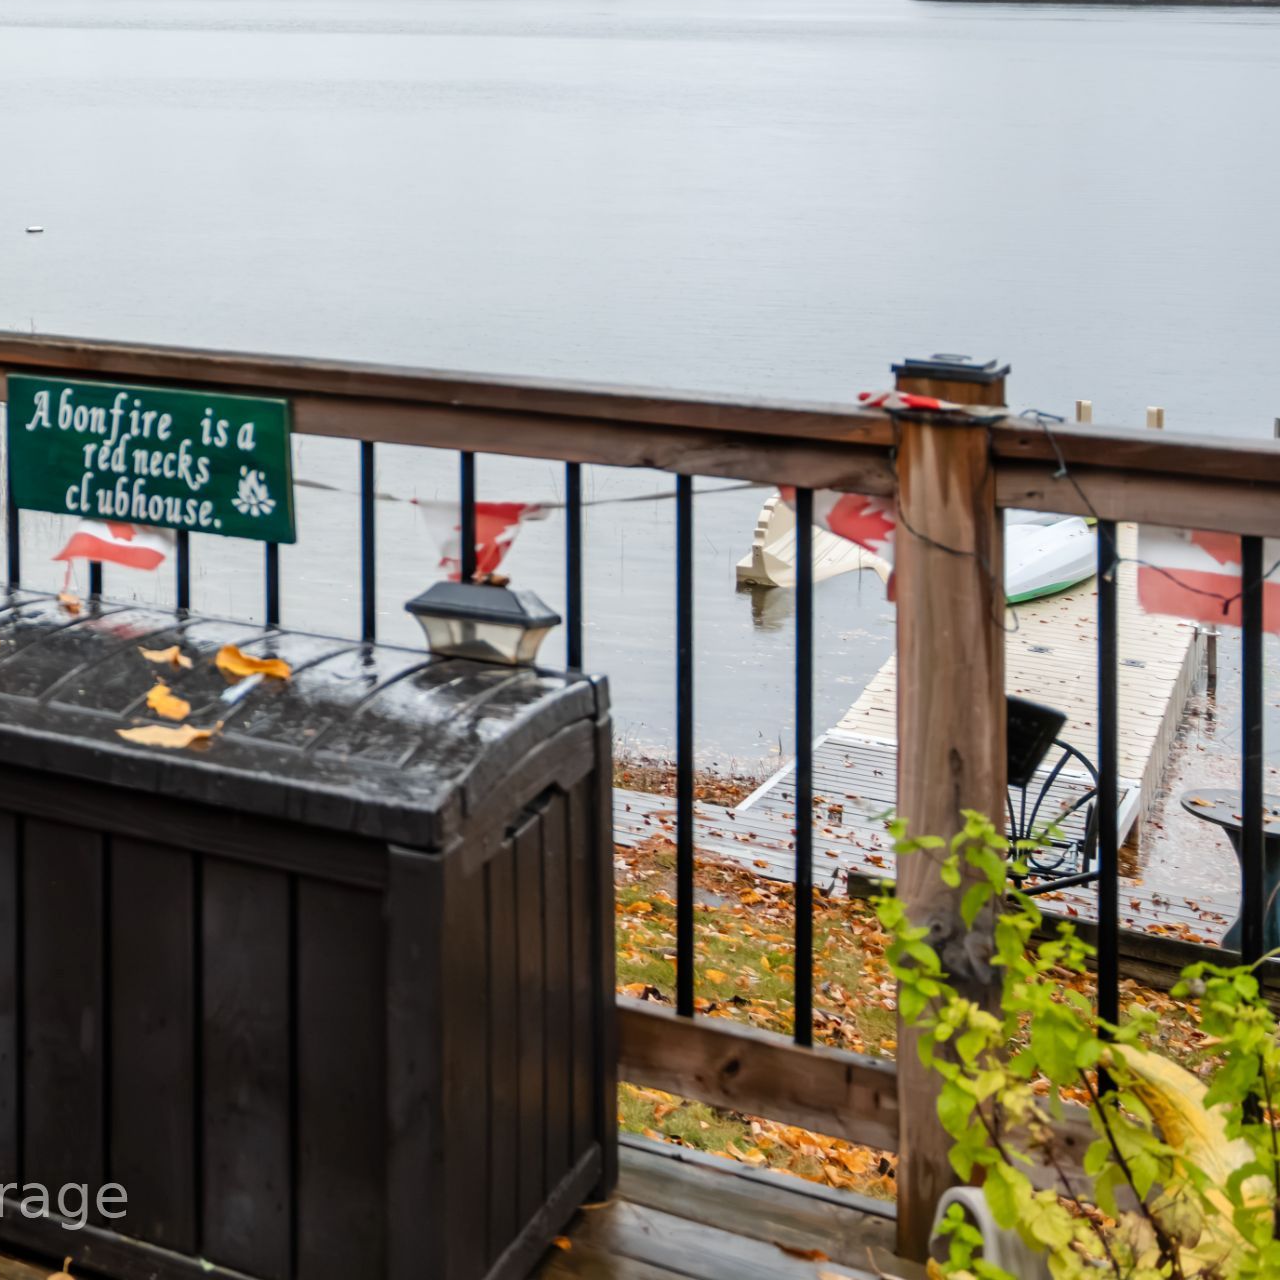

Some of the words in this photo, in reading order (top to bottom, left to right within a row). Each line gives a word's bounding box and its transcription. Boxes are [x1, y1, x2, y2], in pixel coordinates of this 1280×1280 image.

[25, 390, 52, 432] A
[58, 387, 173, 444] bonfire
[201, 407, 230, 448] is
[237, 422, 256, 451] a
